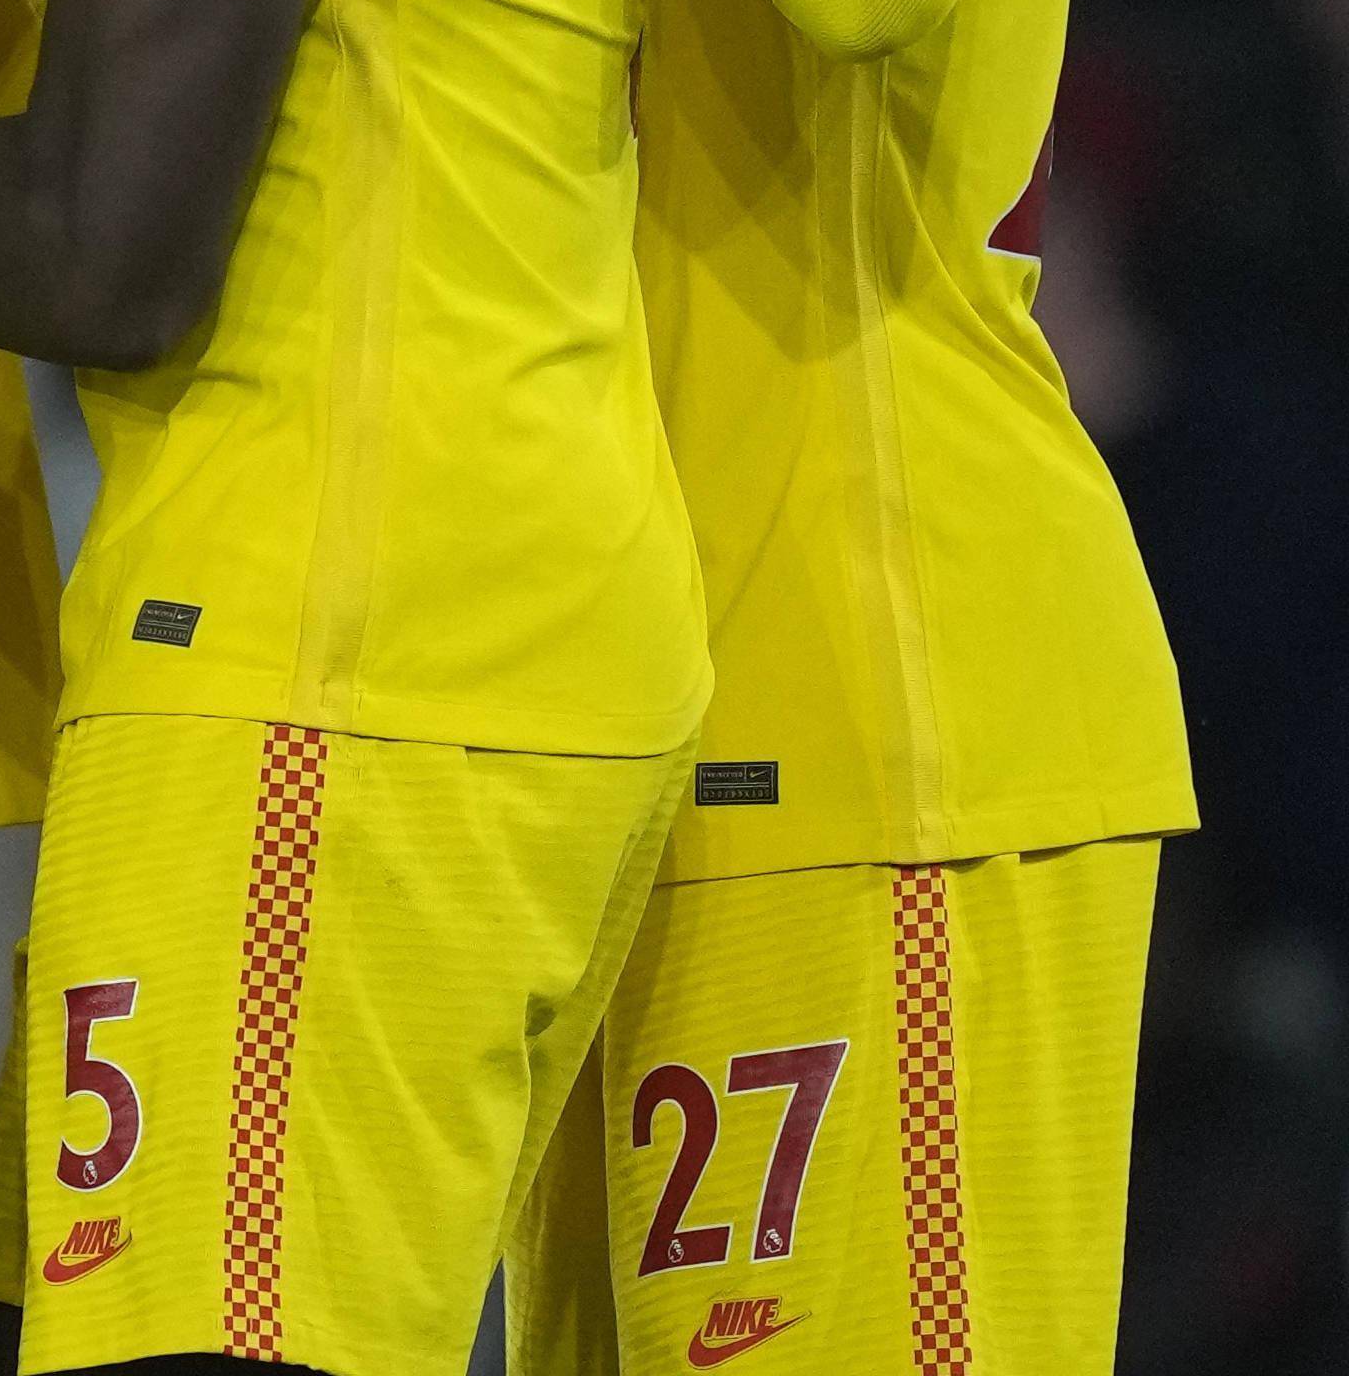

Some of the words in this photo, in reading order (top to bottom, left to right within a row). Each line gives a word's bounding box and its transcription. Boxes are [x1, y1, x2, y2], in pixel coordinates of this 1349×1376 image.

[56, 978, 143, 1192] 5
[632, 1038, 850, 1279] 27
[61, 1216, 121, 1256] NIKE
[703, 1296, 781, 1338] NIKE
